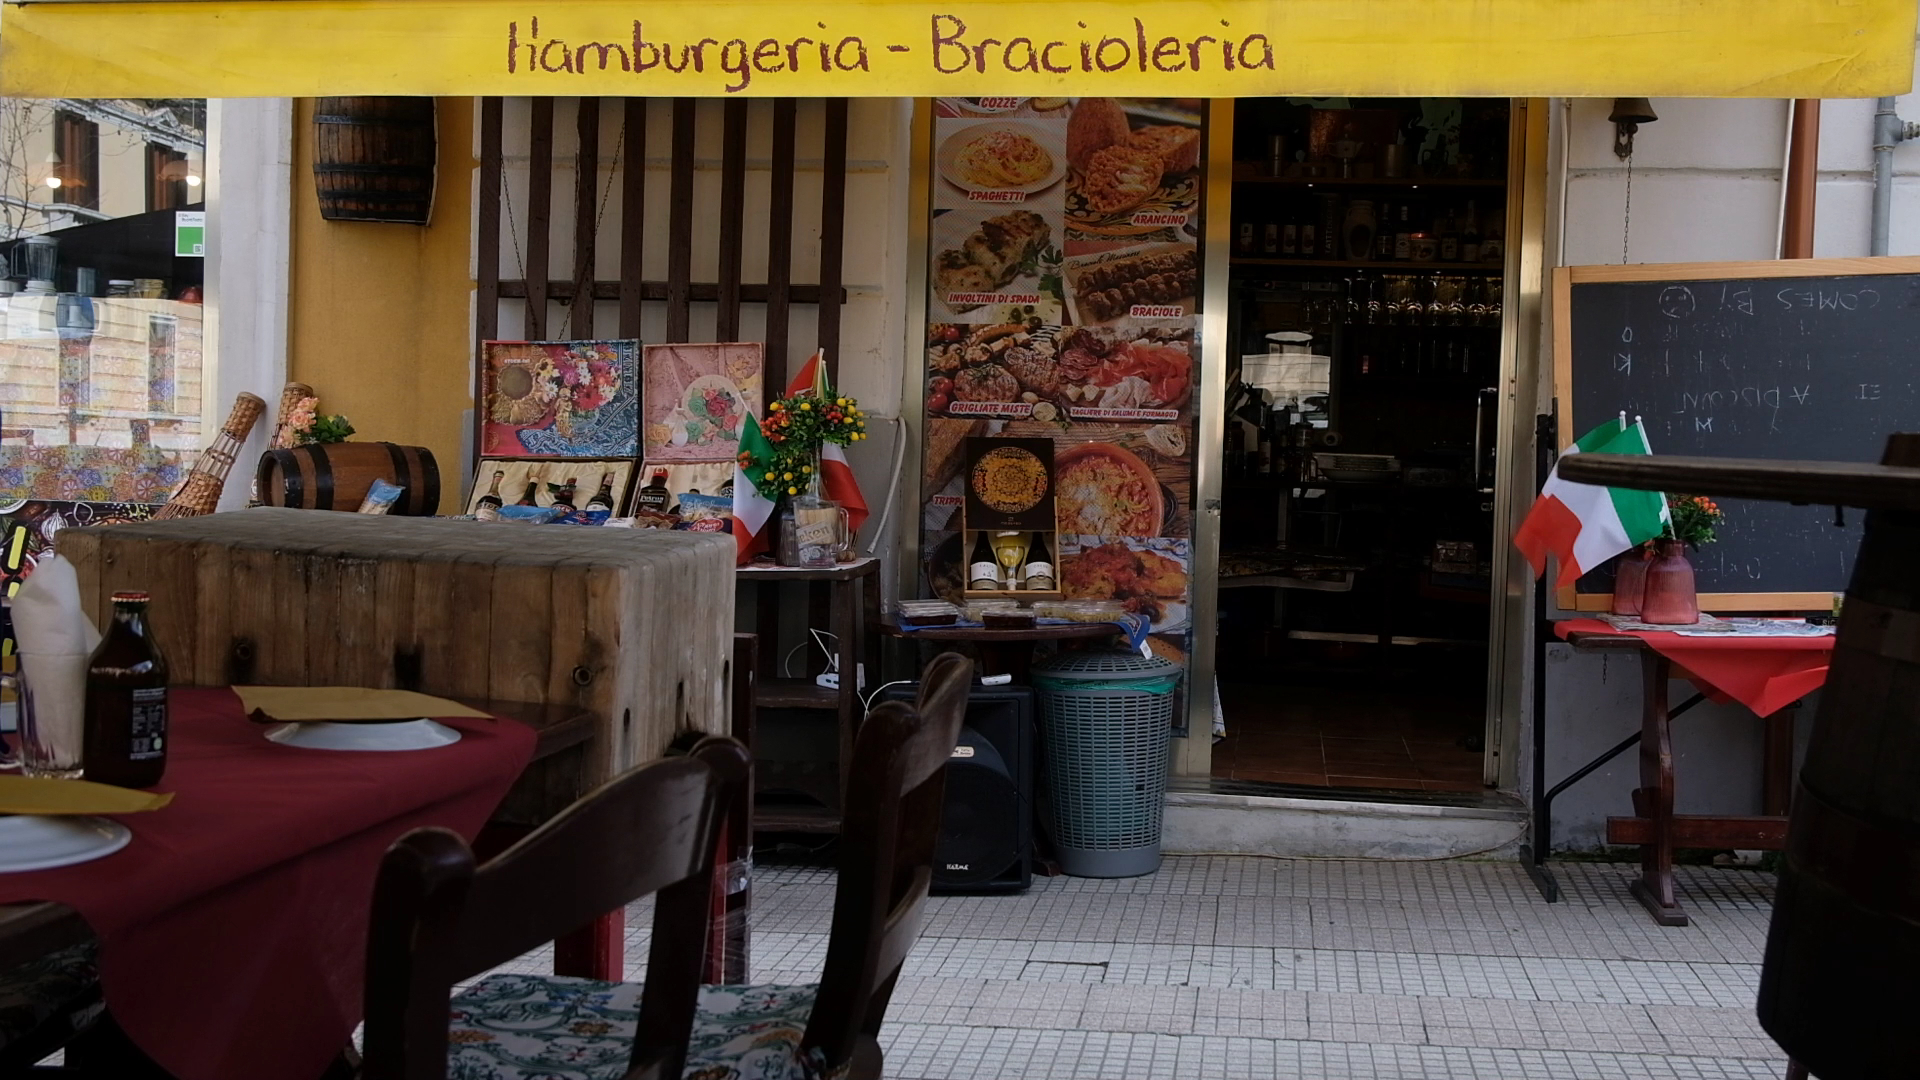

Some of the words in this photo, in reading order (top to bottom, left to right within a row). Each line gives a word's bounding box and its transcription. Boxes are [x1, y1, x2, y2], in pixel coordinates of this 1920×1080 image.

[508, 16, 869, 92] Hamburgeria
[931, 14, 1275, 73] Bracioleria
[981, 97, 1018, 109] COZZE
[968, 191, 1026, 202] SPAGHETTI
[1133, 214, 1187, 226] ARANCINO
[948, 293, 996, 304] INVOLTINI
[997, 294, 1009, 304] DI
[1010, 294, 1040, 304] SPADA
[1132, 306, 1182, 317] BRACIOLE
[951, 402, 1001, 414] GRIGLIATE
[1002, 403, 1032, 414] MISTE
[1071, 408, 1102, 418] TAGLIERE
[1103, 409, 1111, 418] DI
[1112, 409, 1135, 418] SALUMI
[1142, 410, 1178, 419] FORMAGGI
